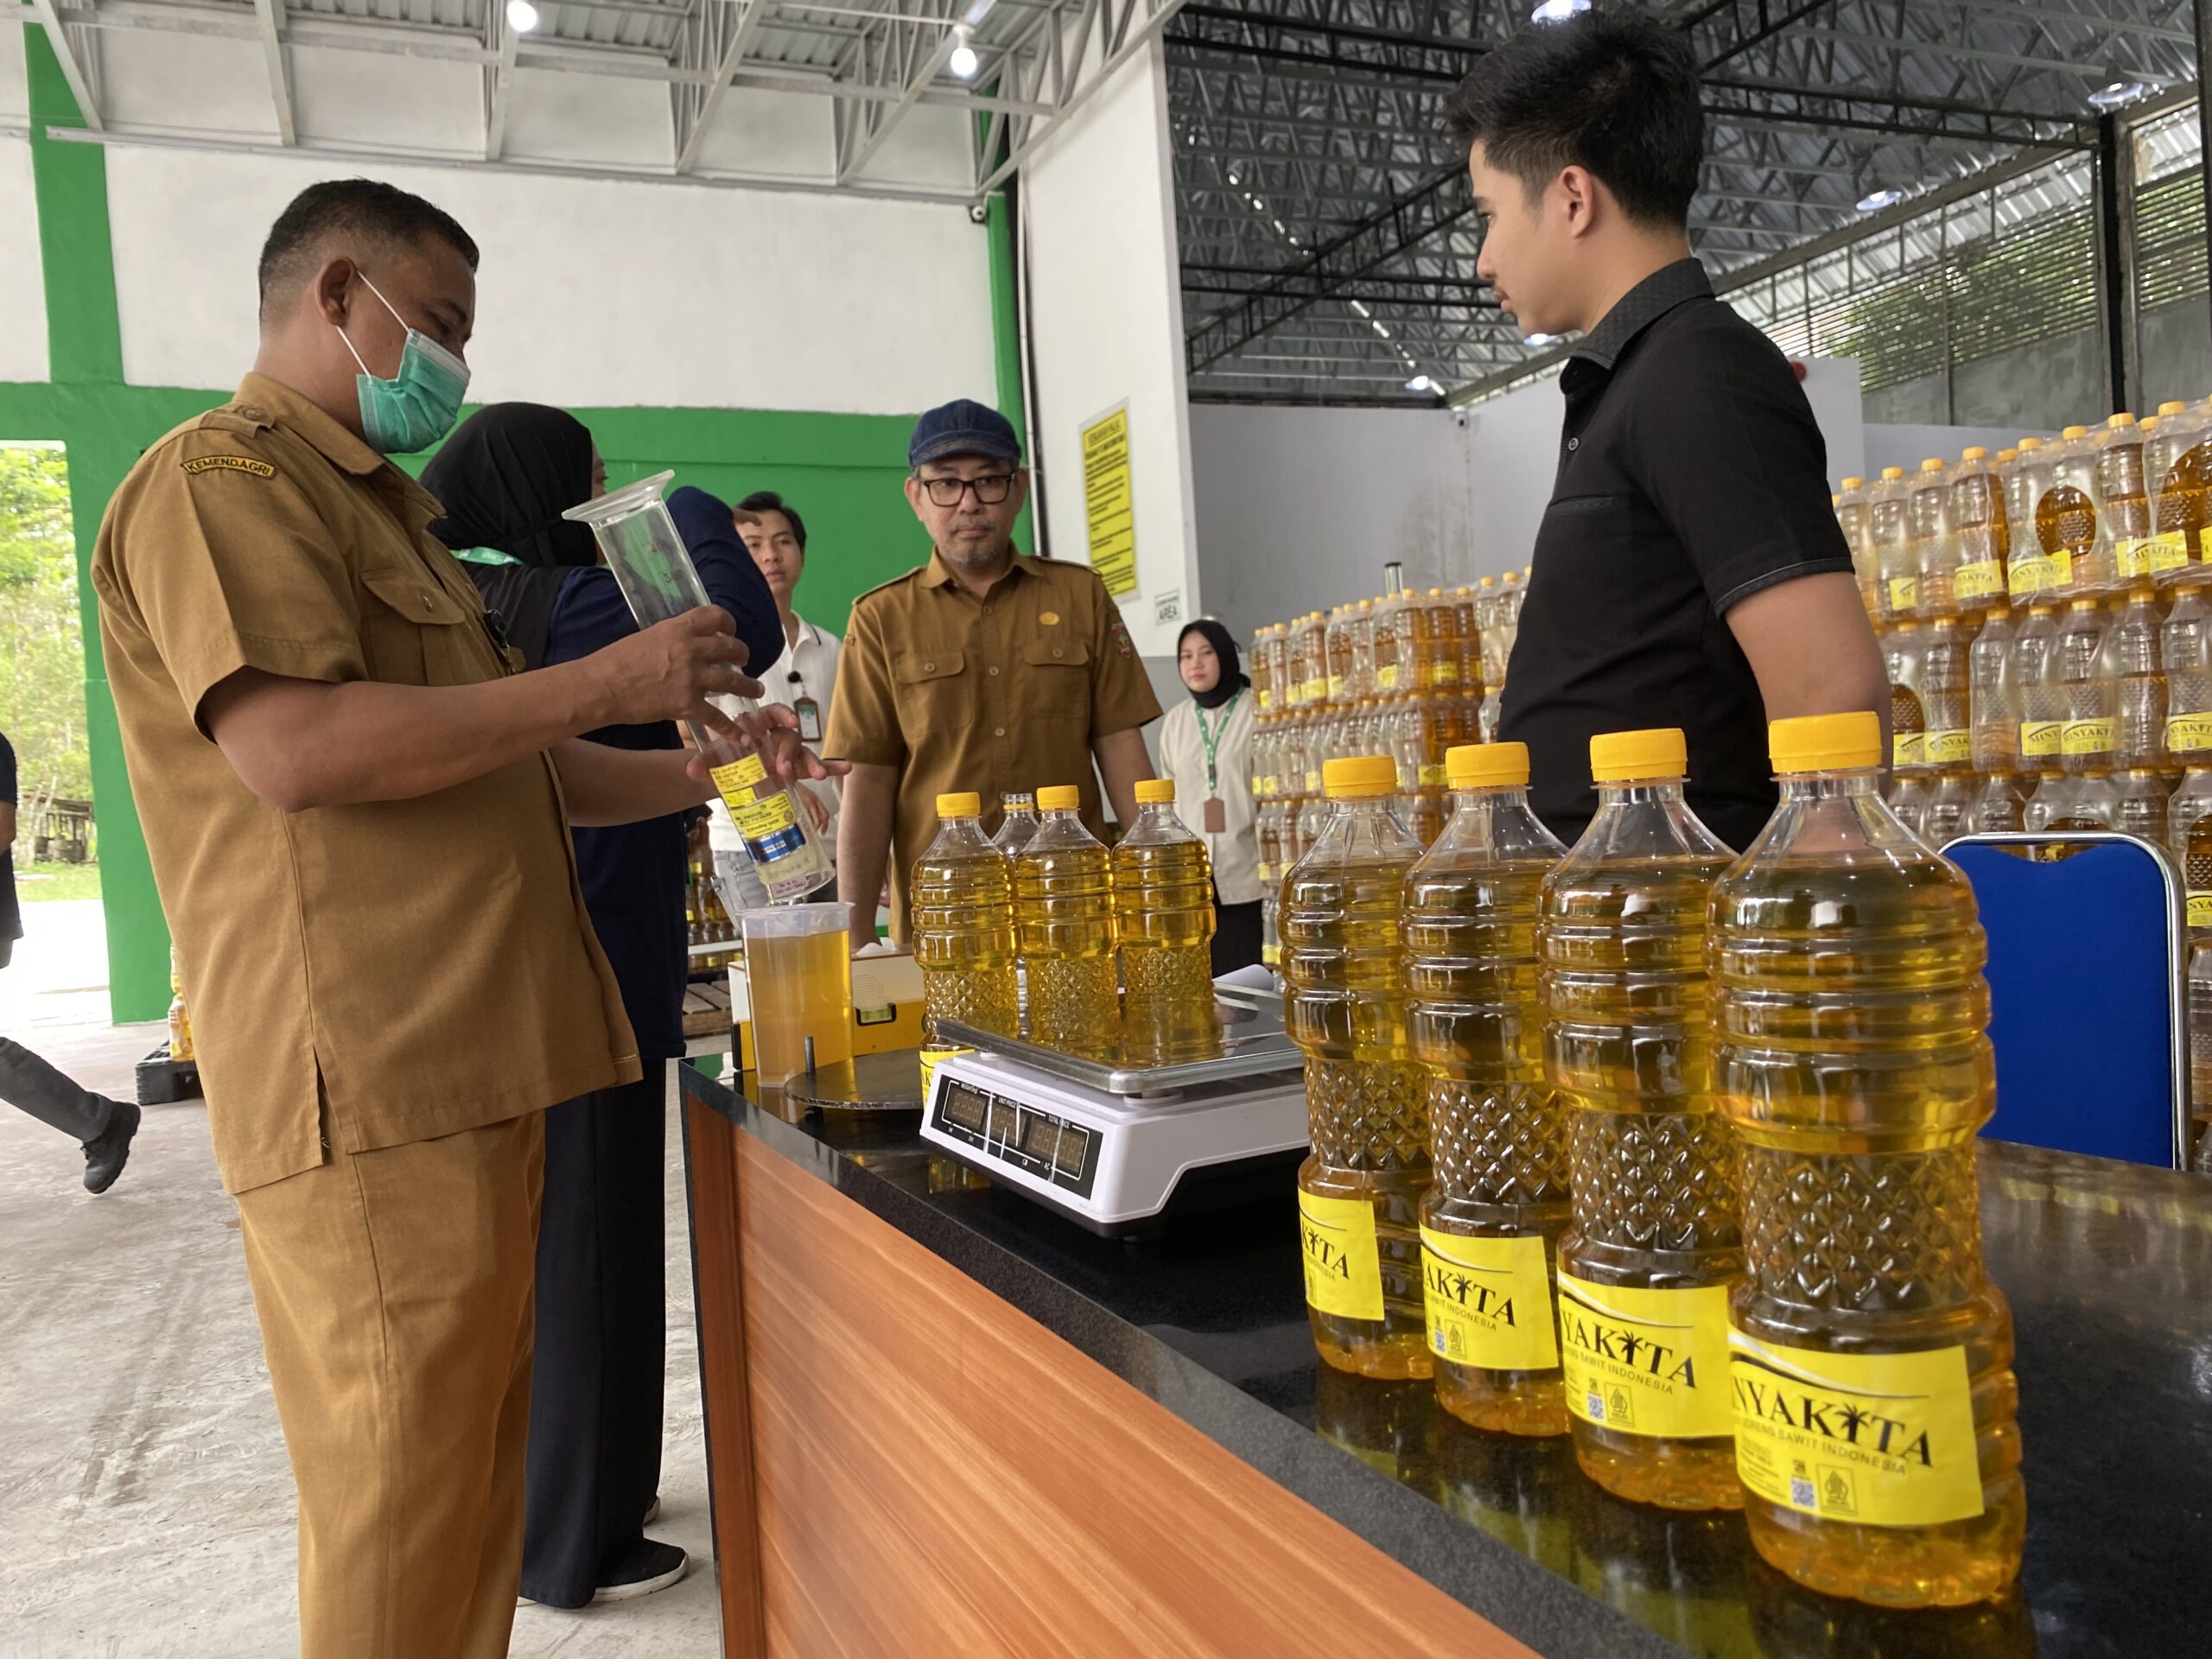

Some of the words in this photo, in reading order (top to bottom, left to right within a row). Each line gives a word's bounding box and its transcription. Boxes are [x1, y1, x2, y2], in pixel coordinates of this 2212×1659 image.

[188, 457, 270, 475] KEMENDAGRI
[1048, 1114, 1059, 1125] TOTAL
[1446, 1302, 1497, 1332] INDONESIA
[1608, 1363, 1674, 1395] INDONESIA
[1777, 1427, 1818, 1450] SAWIT
[1821, 1441, 1907, 1475] INDONESIA
